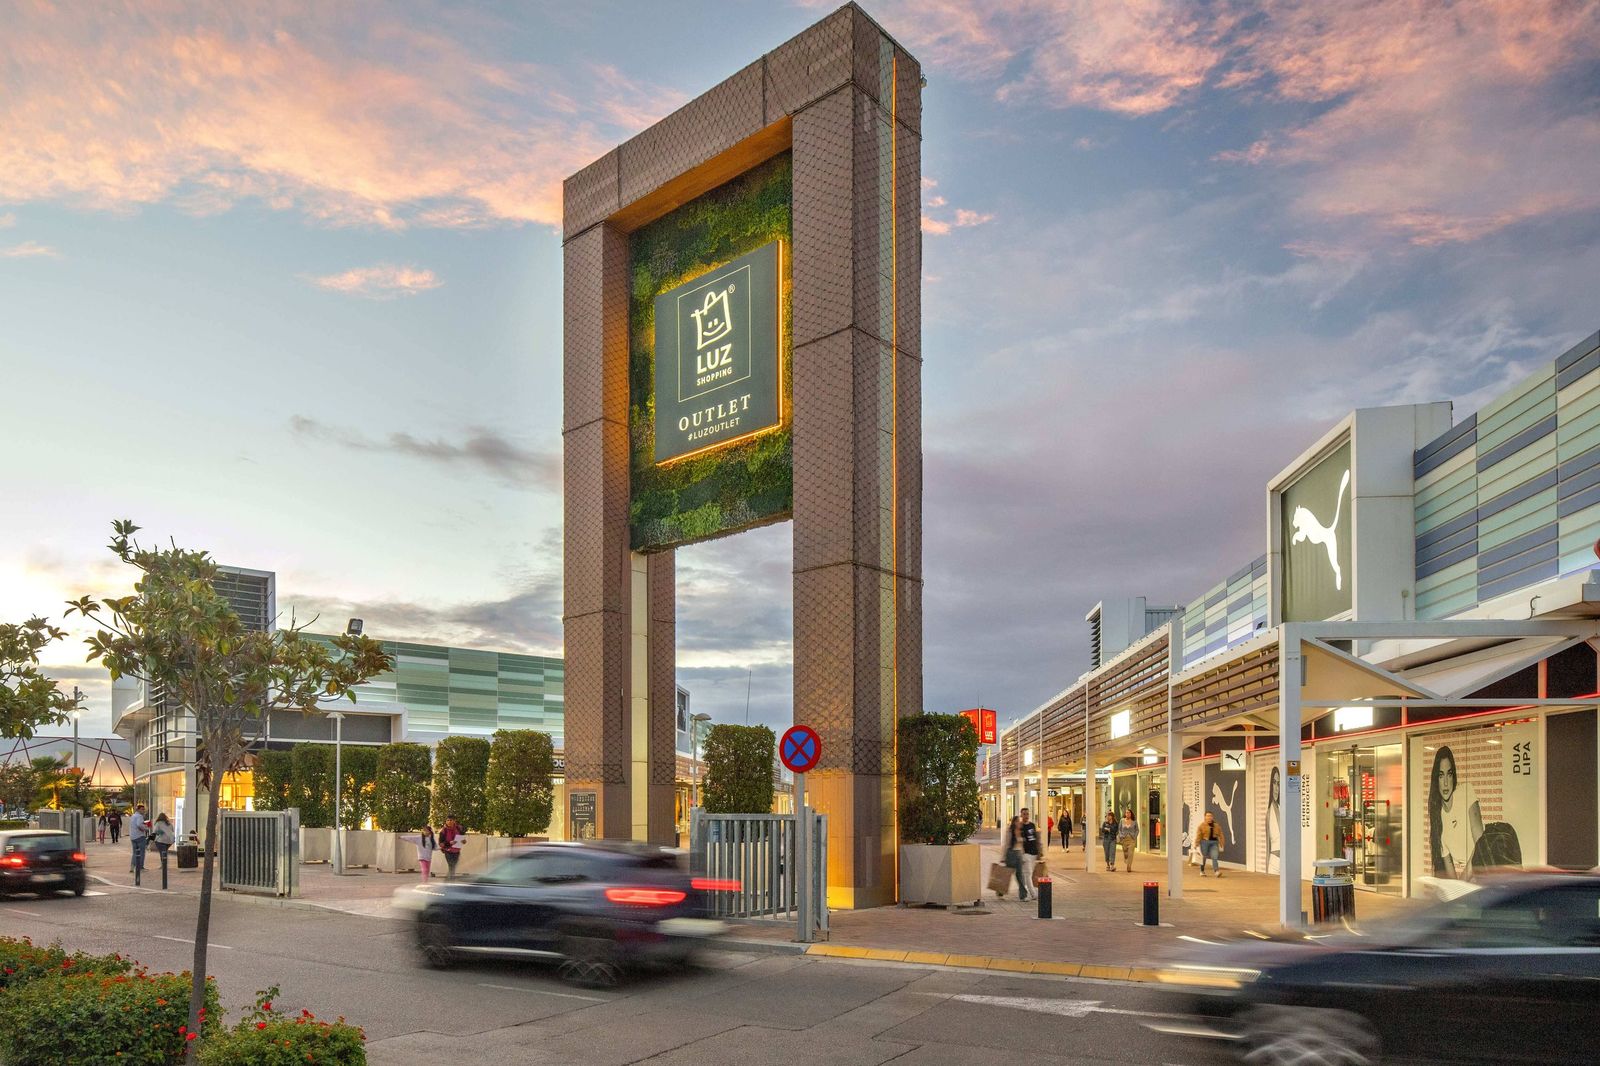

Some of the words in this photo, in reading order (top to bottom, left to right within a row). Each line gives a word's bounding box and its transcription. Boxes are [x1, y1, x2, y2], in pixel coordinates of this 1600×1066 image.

[697, 343, 732, 374] LUZ
[696, 367, 732, 386] SHOPPING
[678, 394, 751, 431] OUTLET
[688, 417, 740, 441] #LUZOUTLET
